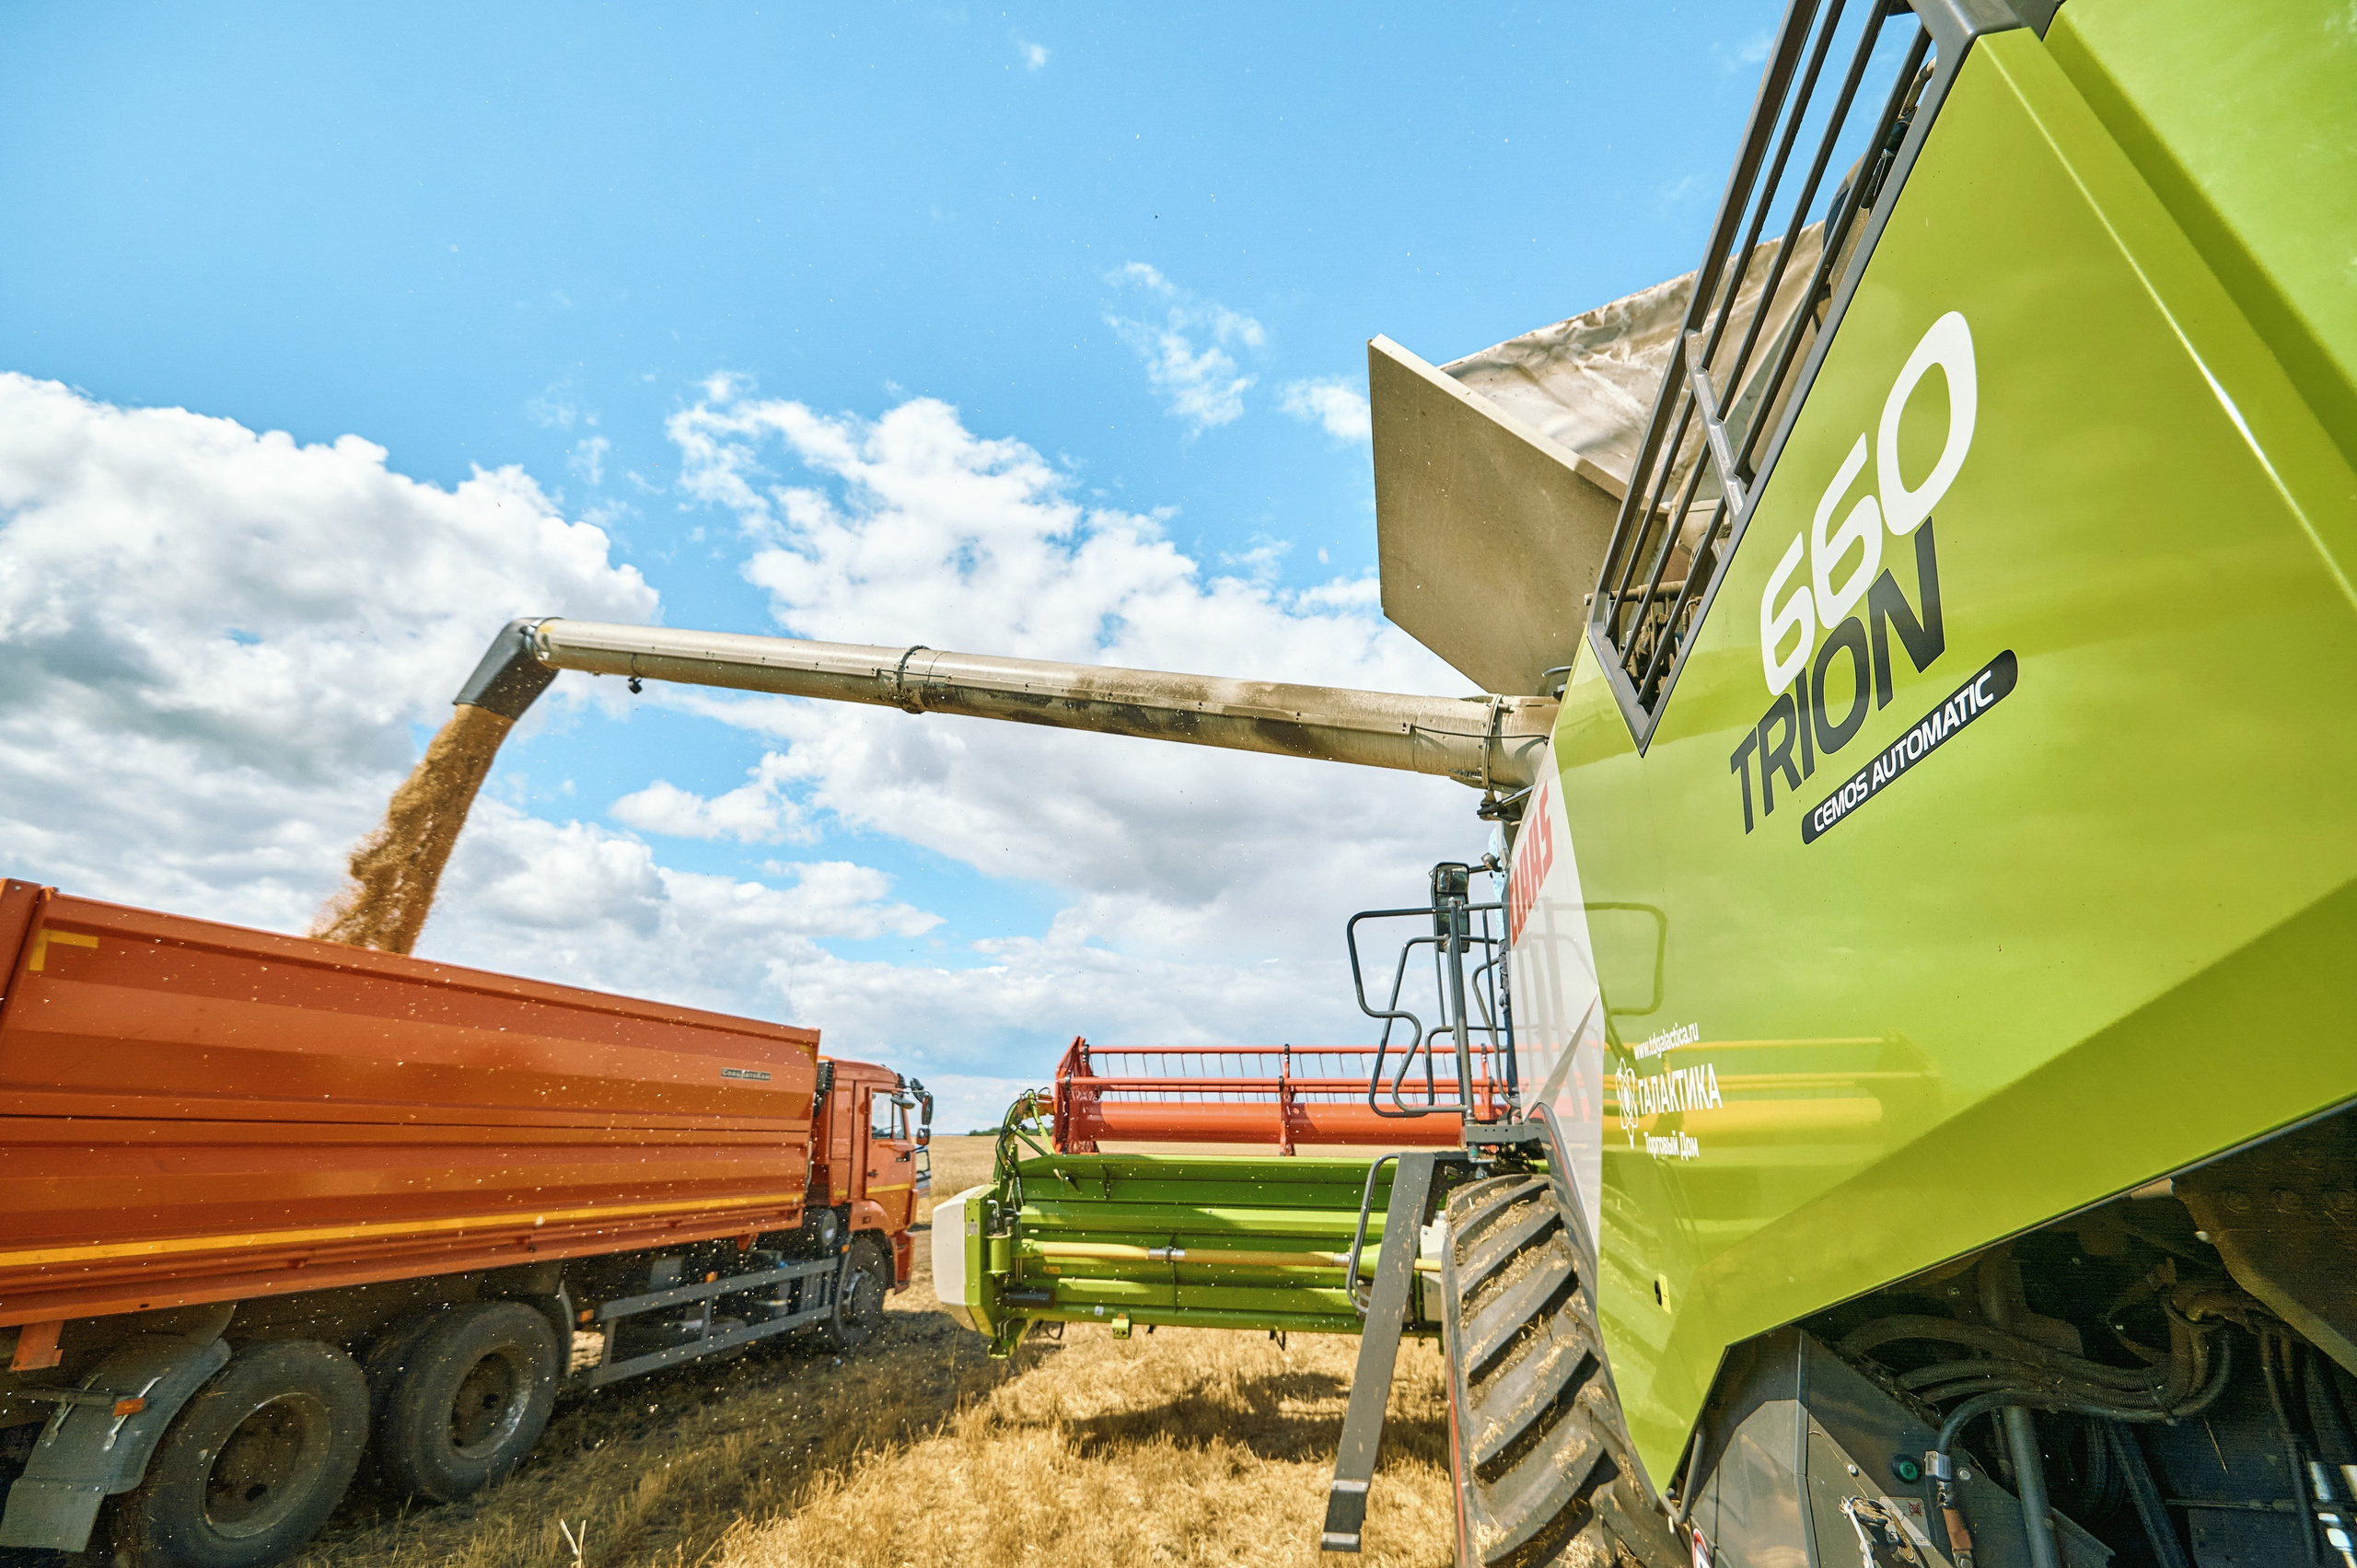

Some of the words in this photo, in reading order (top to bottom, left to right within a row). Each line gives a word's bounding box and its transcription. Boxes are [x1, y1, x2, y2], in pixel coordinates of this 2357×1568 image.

[1760, 311, 1977, 696] 660
[1730, 516, 1945, 835] TRION
[1814, 772, 1868, 832] CEMOS
[1872, 669, 1994, 790] AUTOMATIC
[1509, 780, 1553, 947] CLAAS
[1633, 1022, 1700, 1060] www.tdgalactica.ru
[1638, 1063, 1724, 1115] ГАЛАКТИКА
[1643, 1130, 1679, 1159] Торговый
[1679, 1132, 1700, 1161] Дом
